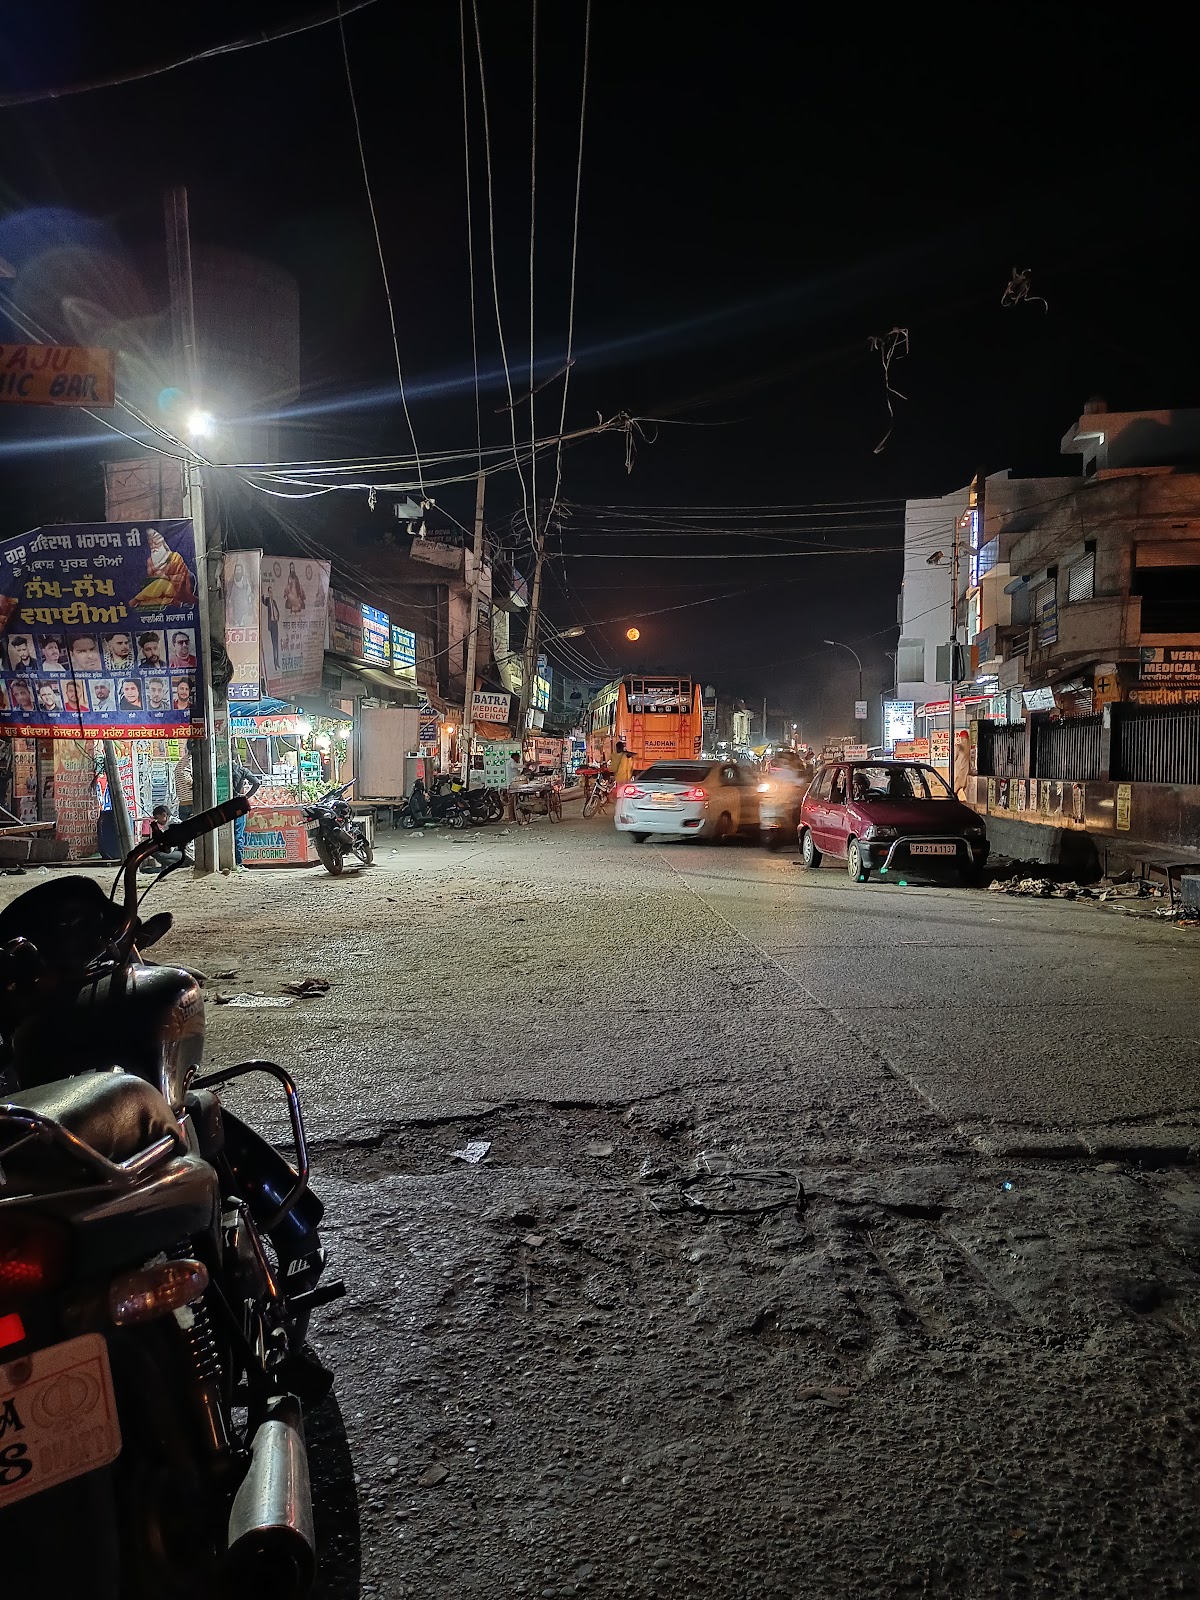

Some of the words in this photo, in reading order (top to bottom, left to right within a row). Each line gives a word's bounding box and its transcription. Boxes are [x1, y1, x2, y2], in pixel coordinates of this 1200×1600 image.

[49, 373, 99, 401] BAR
[76, 532, 122, 549] ਮਹਾਰਾਜ
[126, 527, 141, 547] ਜੀ
[20, 602, 128, 625] ਵਧਾਈਆਂ
[1144, 663, 1197, 673] MEDICAL
[474, 694, 508, 706] BATRA
[472, 704, 508, 714] MEDICAL
[473, 712, 507, 720] AGENCY
[83, 728, 99, 737] ਸਭਾ
[243, 831, 286, 847] JANTA
[242, 850, 260, 859] JUICE
[261, 849, 287, 858] CORNER
